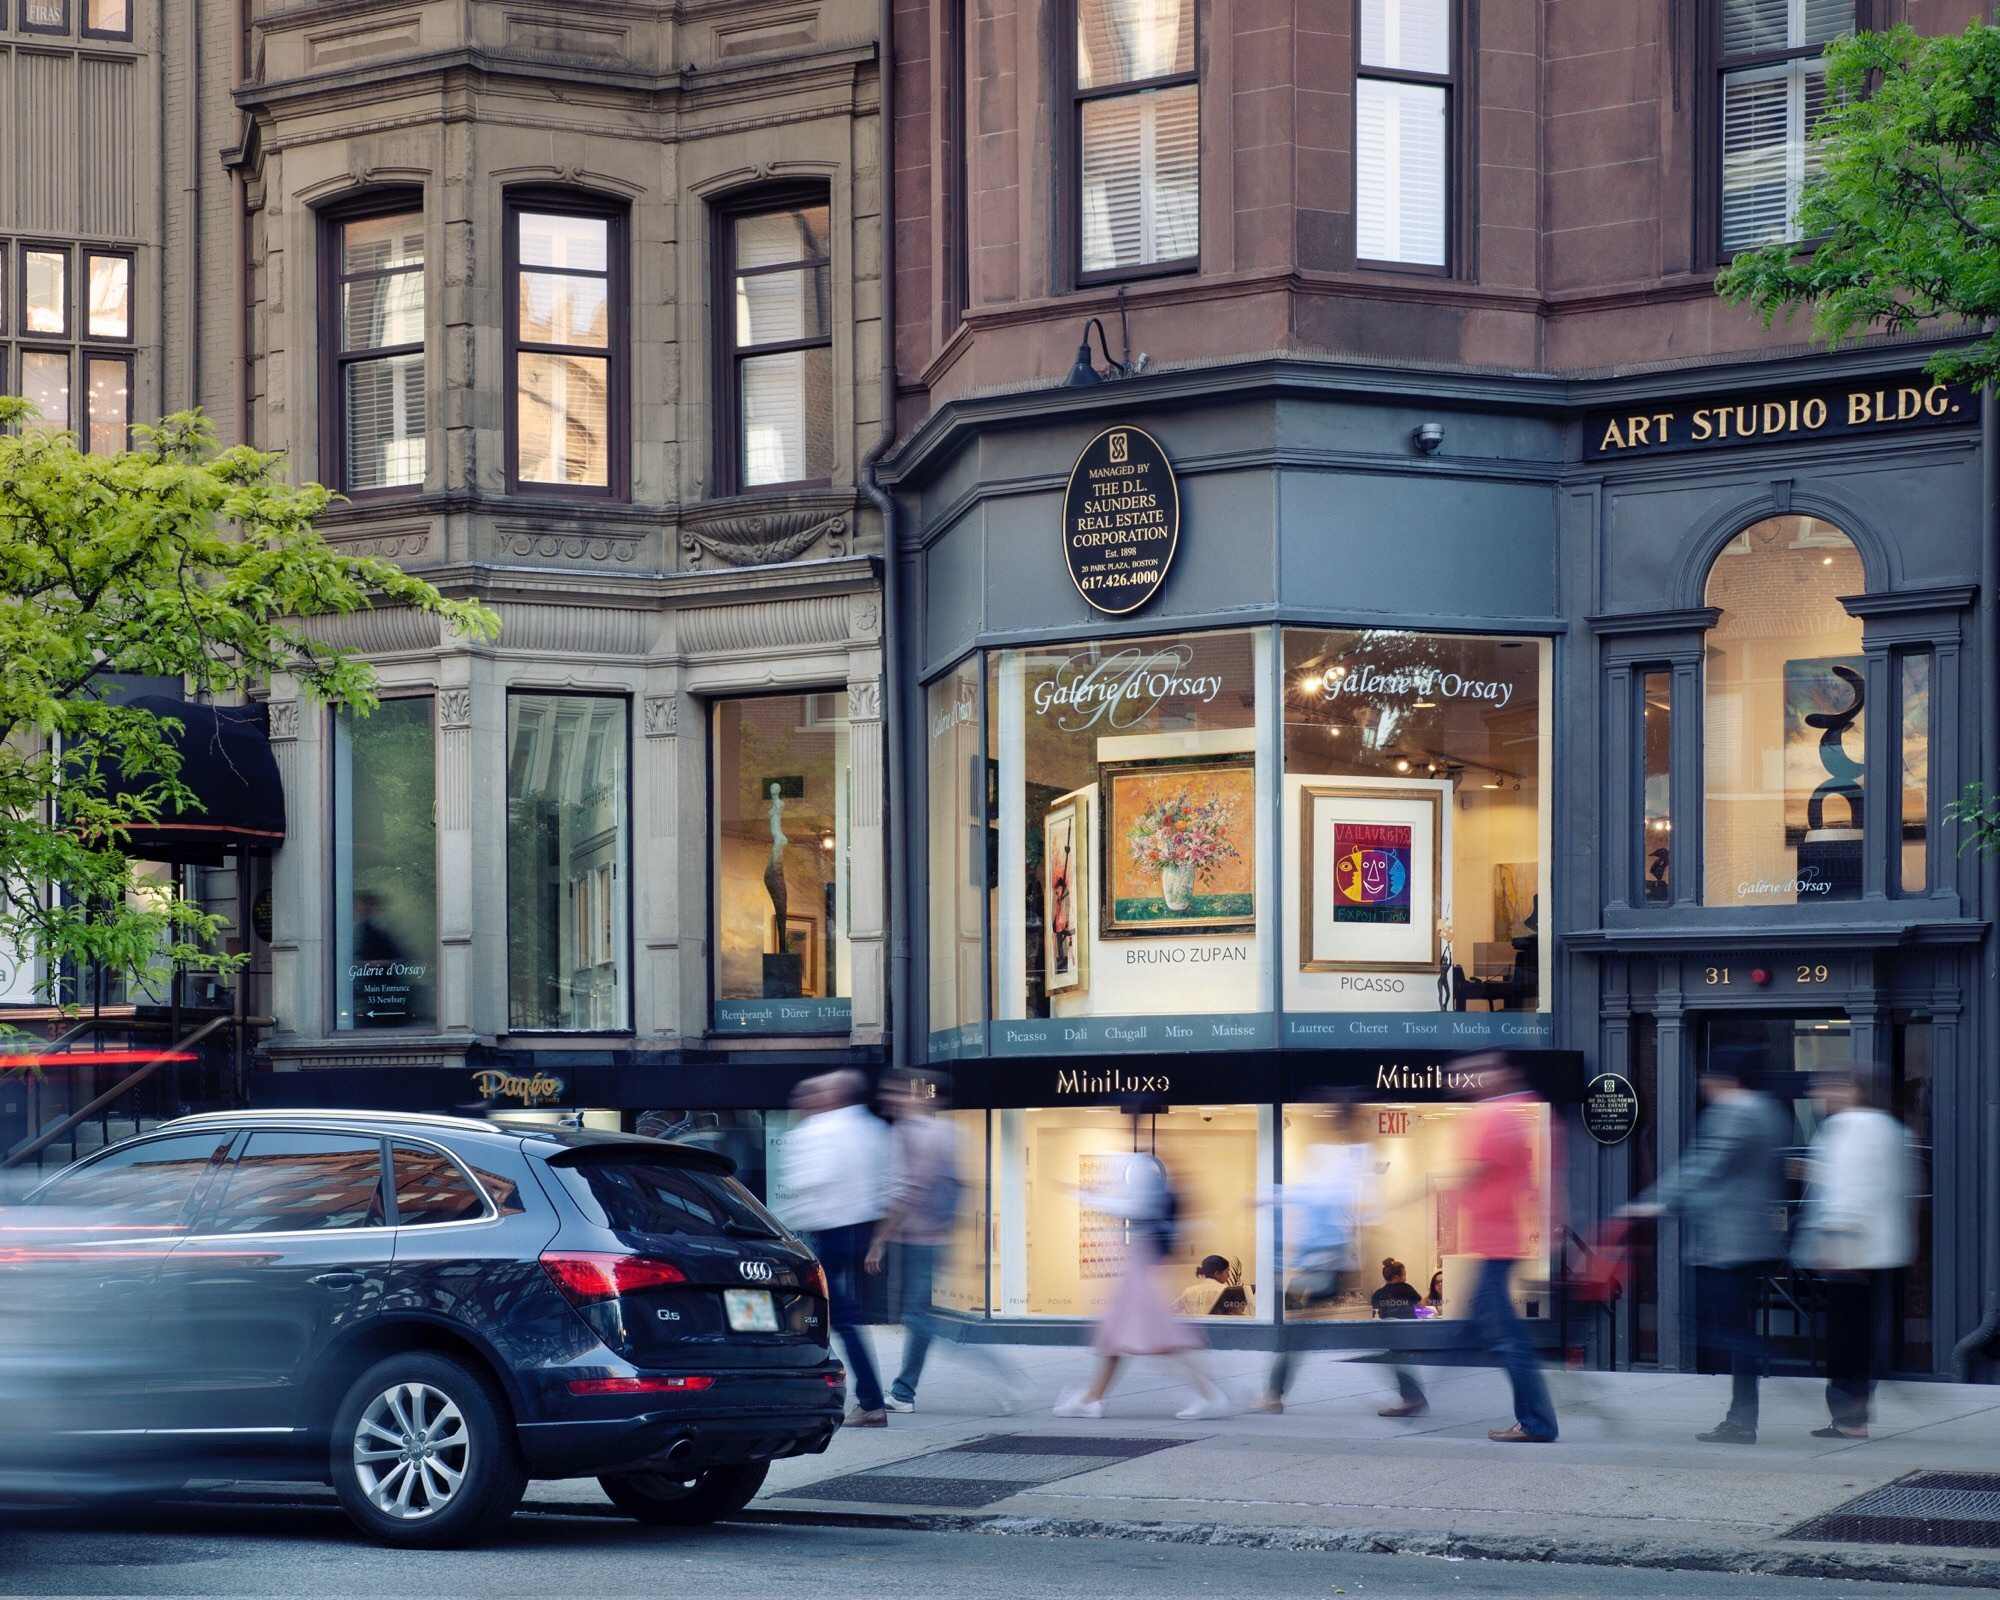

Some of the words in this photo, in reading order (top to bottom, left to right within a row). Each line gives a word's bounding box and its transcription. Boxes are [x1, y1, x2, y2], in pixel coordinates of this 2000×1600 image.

[30, 5, 60, 22] FIRAS
[1600, 413, 1674, 451] ART
[1691, 398, 1827, 441] STUDIO
[1847, 384, 1960, 426] BLDG.
[1089, 465, 1135, 479] MANAGED
[1137, 463, 1150, 474] BY
[1092, 482, 1120, 497] THE
[1122, 479, 1148, 494] D.L.
[1084, 494, 1156, 514] SAUNDERS
[1077, 515, 1113, 532] REAL
[1116, 509, 1164, 528] ESTATE
[1072, 525, 1169, 548] CORPORATION
[1105, 549, 1119, 558] Est.
[1120, 547, 1137, 557] 1898
[1081, 565, 1089, 573] 20
[1090, 563, 1106, 572] PARK
[1107, 561, 1131, 571] PLAZA,
[1132, 558, 1158, 569] BOSTON
[1081, 570, 1158, 590] 617.426.4000
[1034, 674, 1118, 715] Galerie
[1125, 671, 1222, 703] d'Orsay
[1322, 664, 1410, 700] Galerie
[1418, 669, 1513, 708] d'Orsay
[1737, 879, 1780, 898] Galerie
[1783, 879, 1832, 895] d'Orsay
[1126, 948, 1186, 964] BRUNO
[1190, 946, 1246, 963] ZUPAN
[348, 962, 384, 981] Galerie
[386, 962, 426, 979] d'Orsay
[1705, 967, 1731, 985] 31
[1796, 965, 1829, 983] 29
[364, 984, 380, 993] Main
[381, 984, 410, 993] Entrance
[1341, 976, 1405, 993] PICASSO
[367, 996, 376, 1004] 33
[377, 995, 407, 1005] Newbury
[721, 1008, 773, 1020] Rembrandt
[780, 1007, 810, 1018] Dürer
[1006, 1030, 1047, 1042] Picasso
[1064, 1028, 1088, 1041] Dali
[1105, 1026, 1147, 1042] Chagall
[1164, 1025, 1194, 1038] Miro
[1211, 1024, 1256, 1037] Matisse
[1290, 1022, 1335, 1034] Lautrec
[1349, 1021, 1389, 1034] Cheret
[1402, 1021, 1439, 1034] Tissot
[1452, 1022, 1491, 1035] Mucha
[1501, 1022, 1549, 1035] Cezanne
[1378, 1112, 1408, 1134] EXIT
[1379, 1299, 1409, 1307] GROOM
[656, 1308, 681, 1321] Q5
